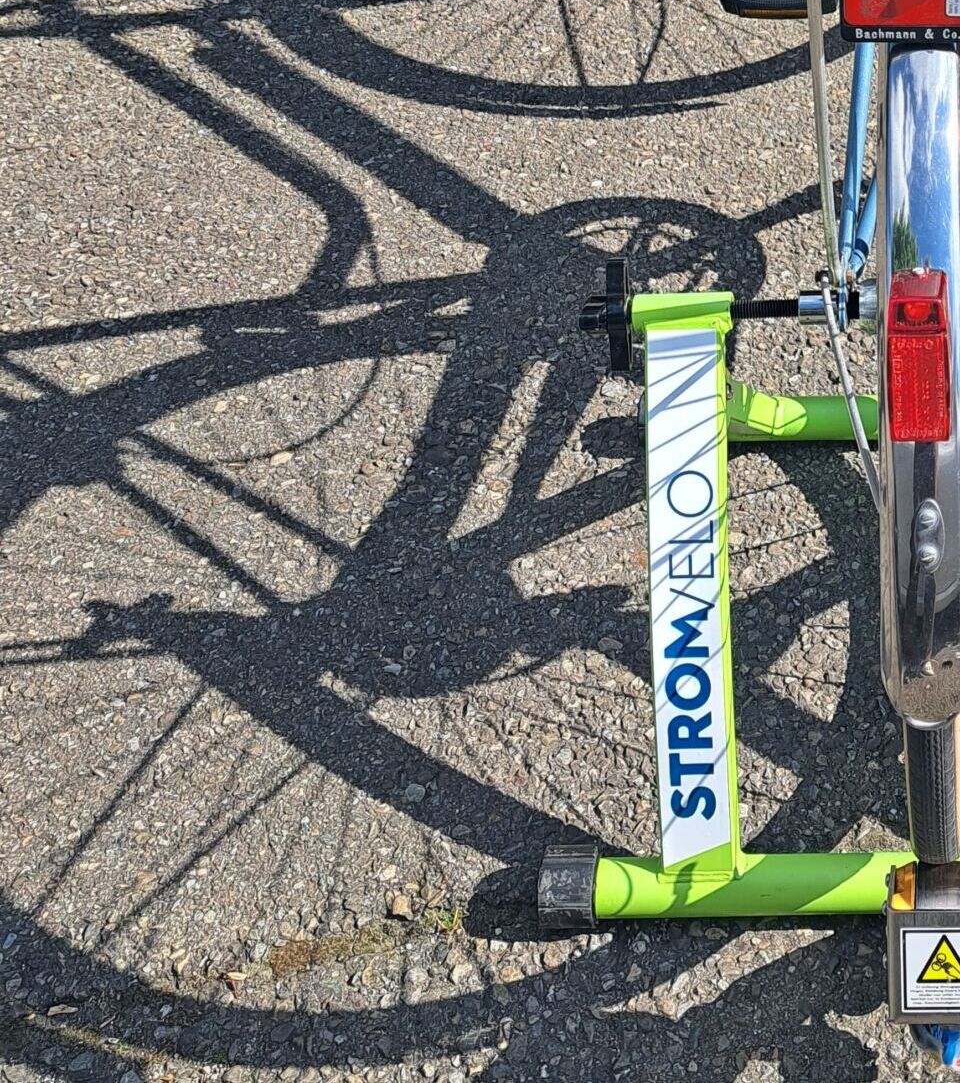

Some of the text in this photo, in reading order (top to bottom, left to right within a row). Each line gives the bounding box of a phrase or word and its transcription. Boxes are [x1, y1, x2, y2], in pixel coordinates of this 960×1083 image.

[855, 28, 917, 39] Bachmann
[924, 28, 934, 39] &
[664, 469, 717, 822] STROMVELO
